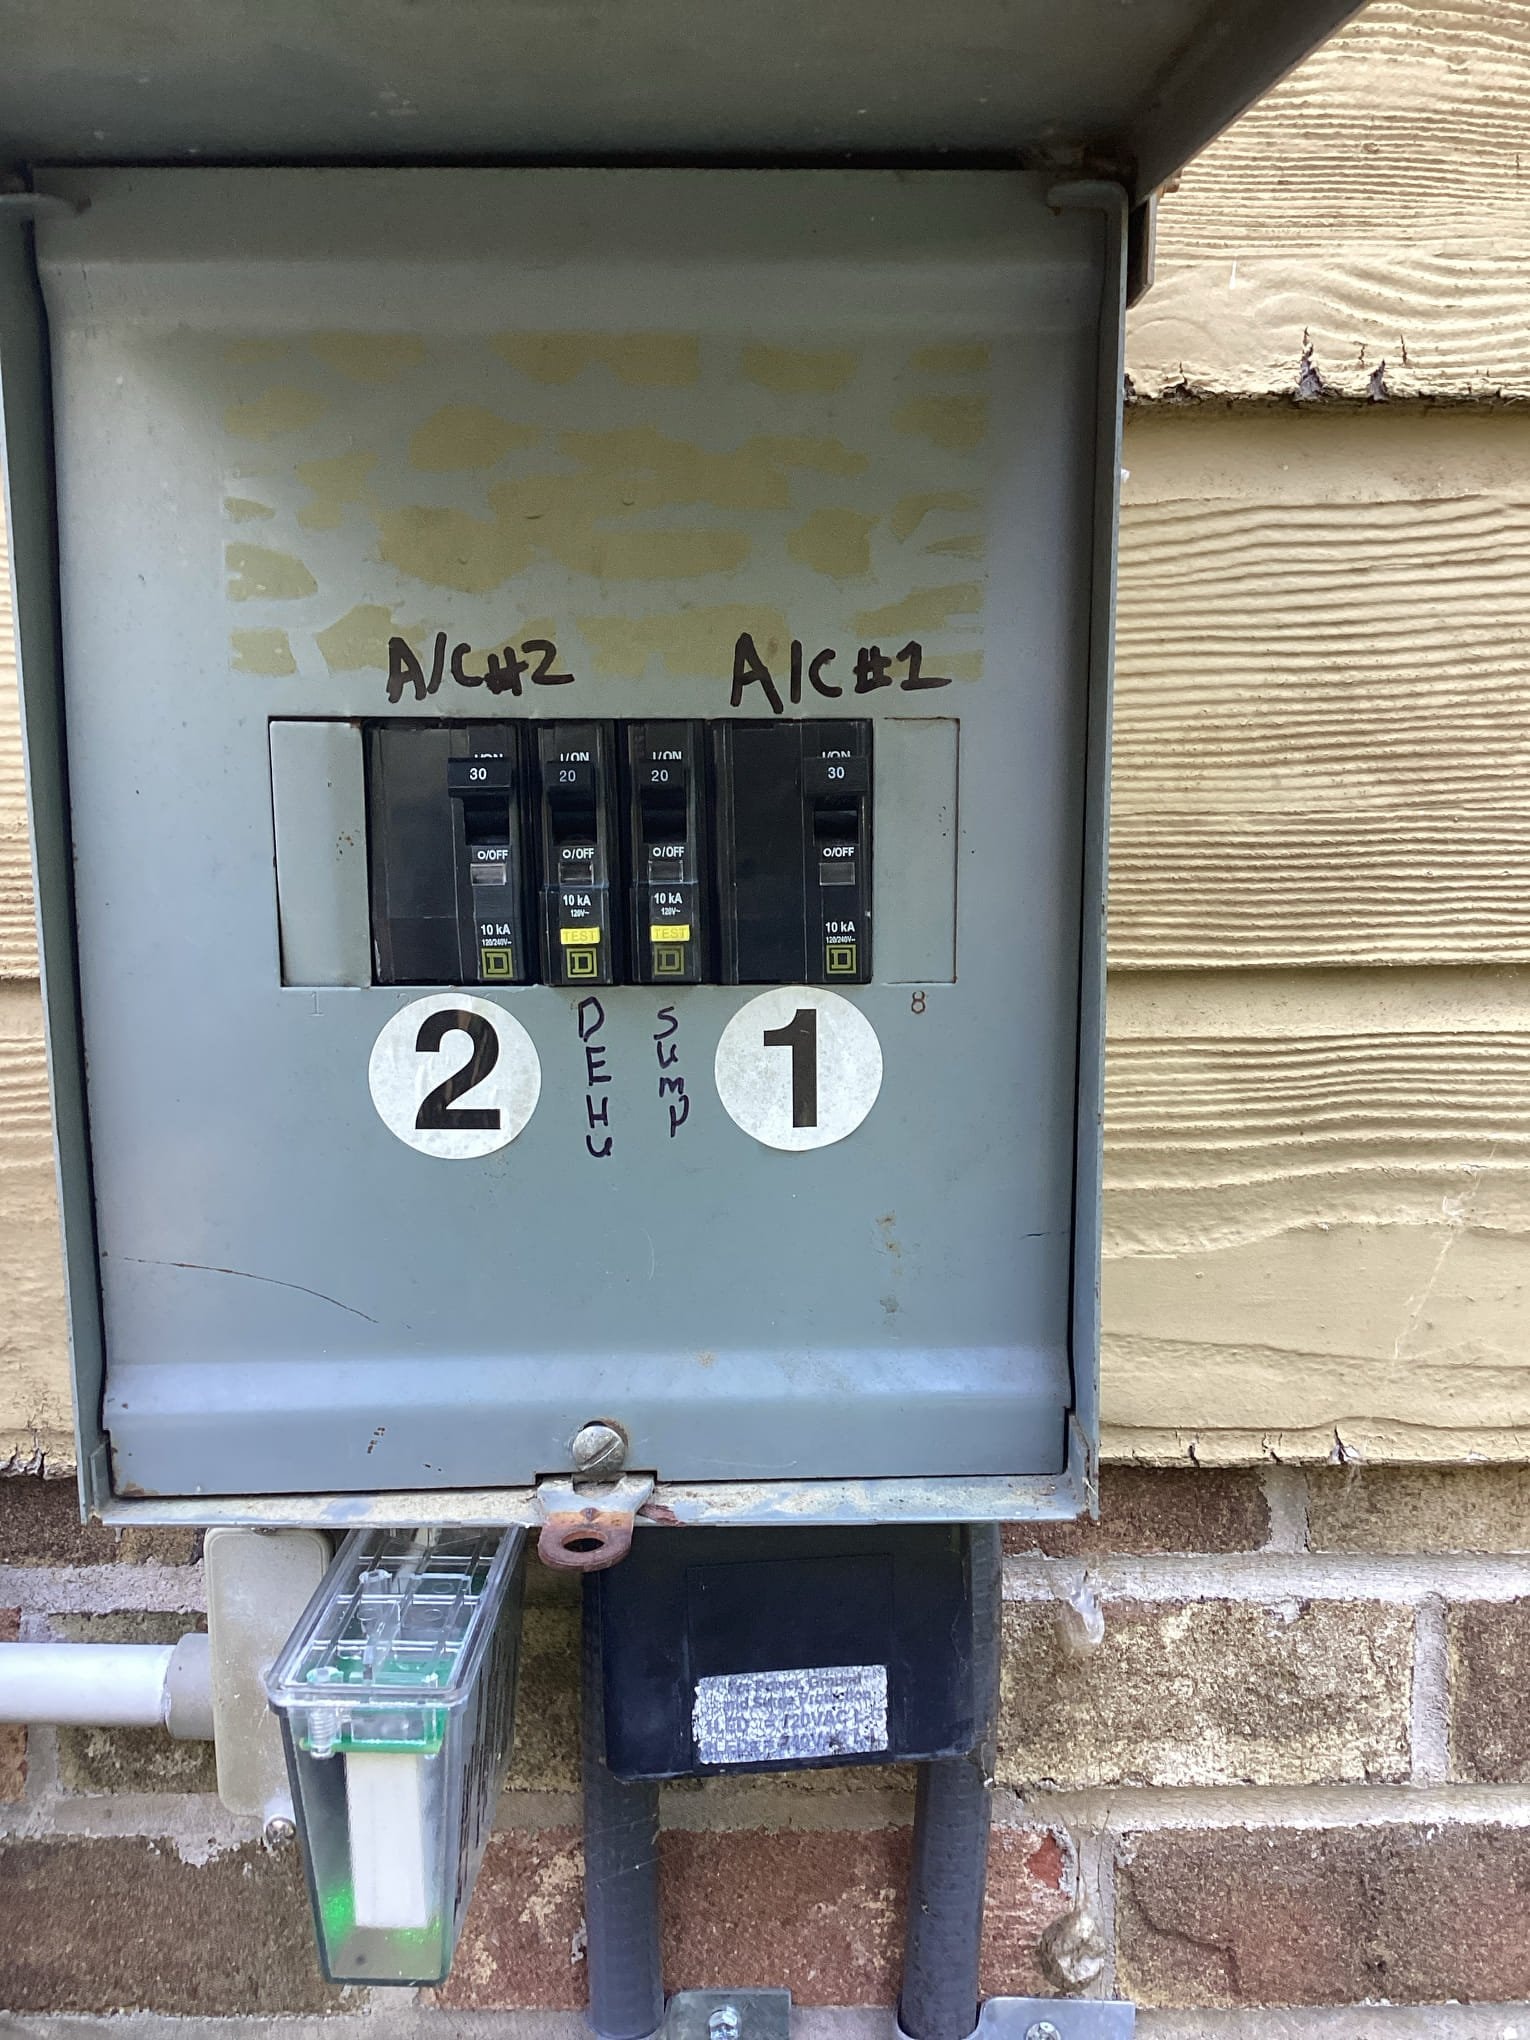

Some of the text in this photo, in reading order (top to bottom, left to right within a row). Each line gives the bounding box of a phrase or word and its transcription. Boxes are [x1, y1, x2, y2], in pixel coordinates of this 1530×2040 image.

[469, 767, 487, 781] 30
[559, 769, 576, 783] 20
[651, 769, 669, 782] 20
[827, 766, 845, 779] 30
[562, 894, 592, 906] 10 kA
[653, 892, 683, 905] 10 kA
[480, 923, 511, 936] 10 kA
[654, 926, 688, 940] TEST
[825, 920, 856, 933] 10 kA
[563, 929, 597, 942] TEST
[911, 990, 926, 1015] 8
[415, 1009, 501, 1130] 2
[763, 1008, 818, 1128] 1
